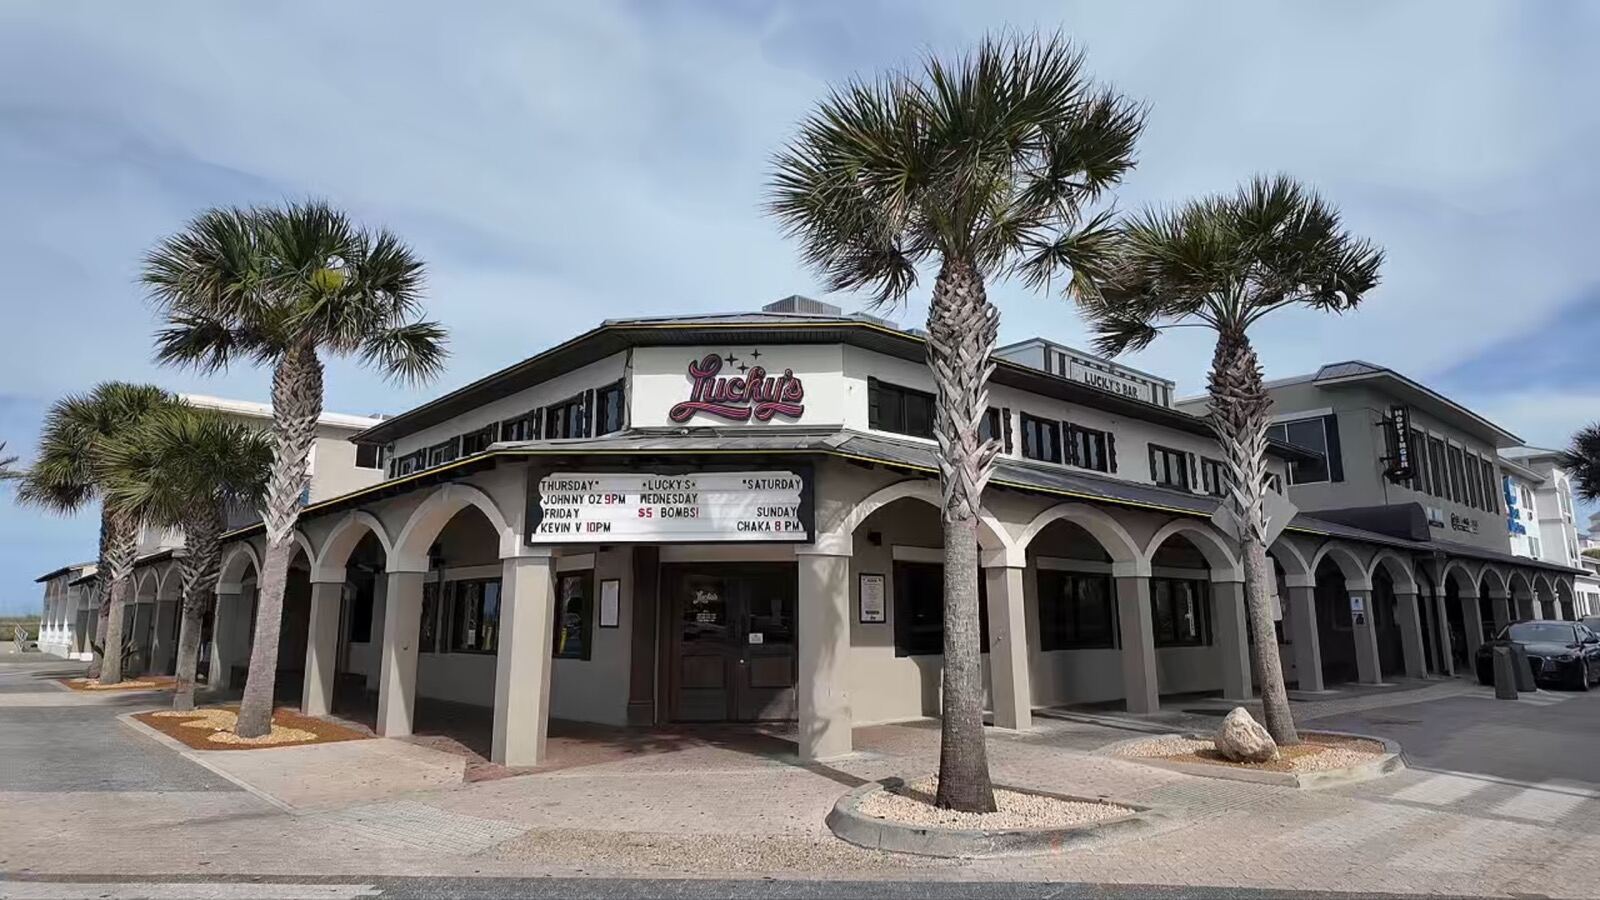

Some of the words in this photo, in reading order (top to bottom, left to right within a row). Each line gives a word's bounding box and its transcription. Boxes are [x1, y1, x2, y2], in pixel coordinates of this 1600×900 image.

[669, 353, 804, 422] Lucky's
[1122, 383, 1138, 398] BAR
[543, 494, 585, 505] JOHNNY
[588, 494, 602, 505] OZ
[604, 494, 626, 505] 9PM
[544, 508, 580, 519] FRIDAY
[660, 506, 700, 518] BOMBS!
[756, 506, 797, 517] SUNDAY
[540, 522, 571, 533] KEVIN
[575, 522, 582, 533] V
[586, 522, 611, 533] 10PM
[736, 520, 771, 532] CHAKA
[774, 520, 782, 532] 8
[784, 520, 800, 531] PM
